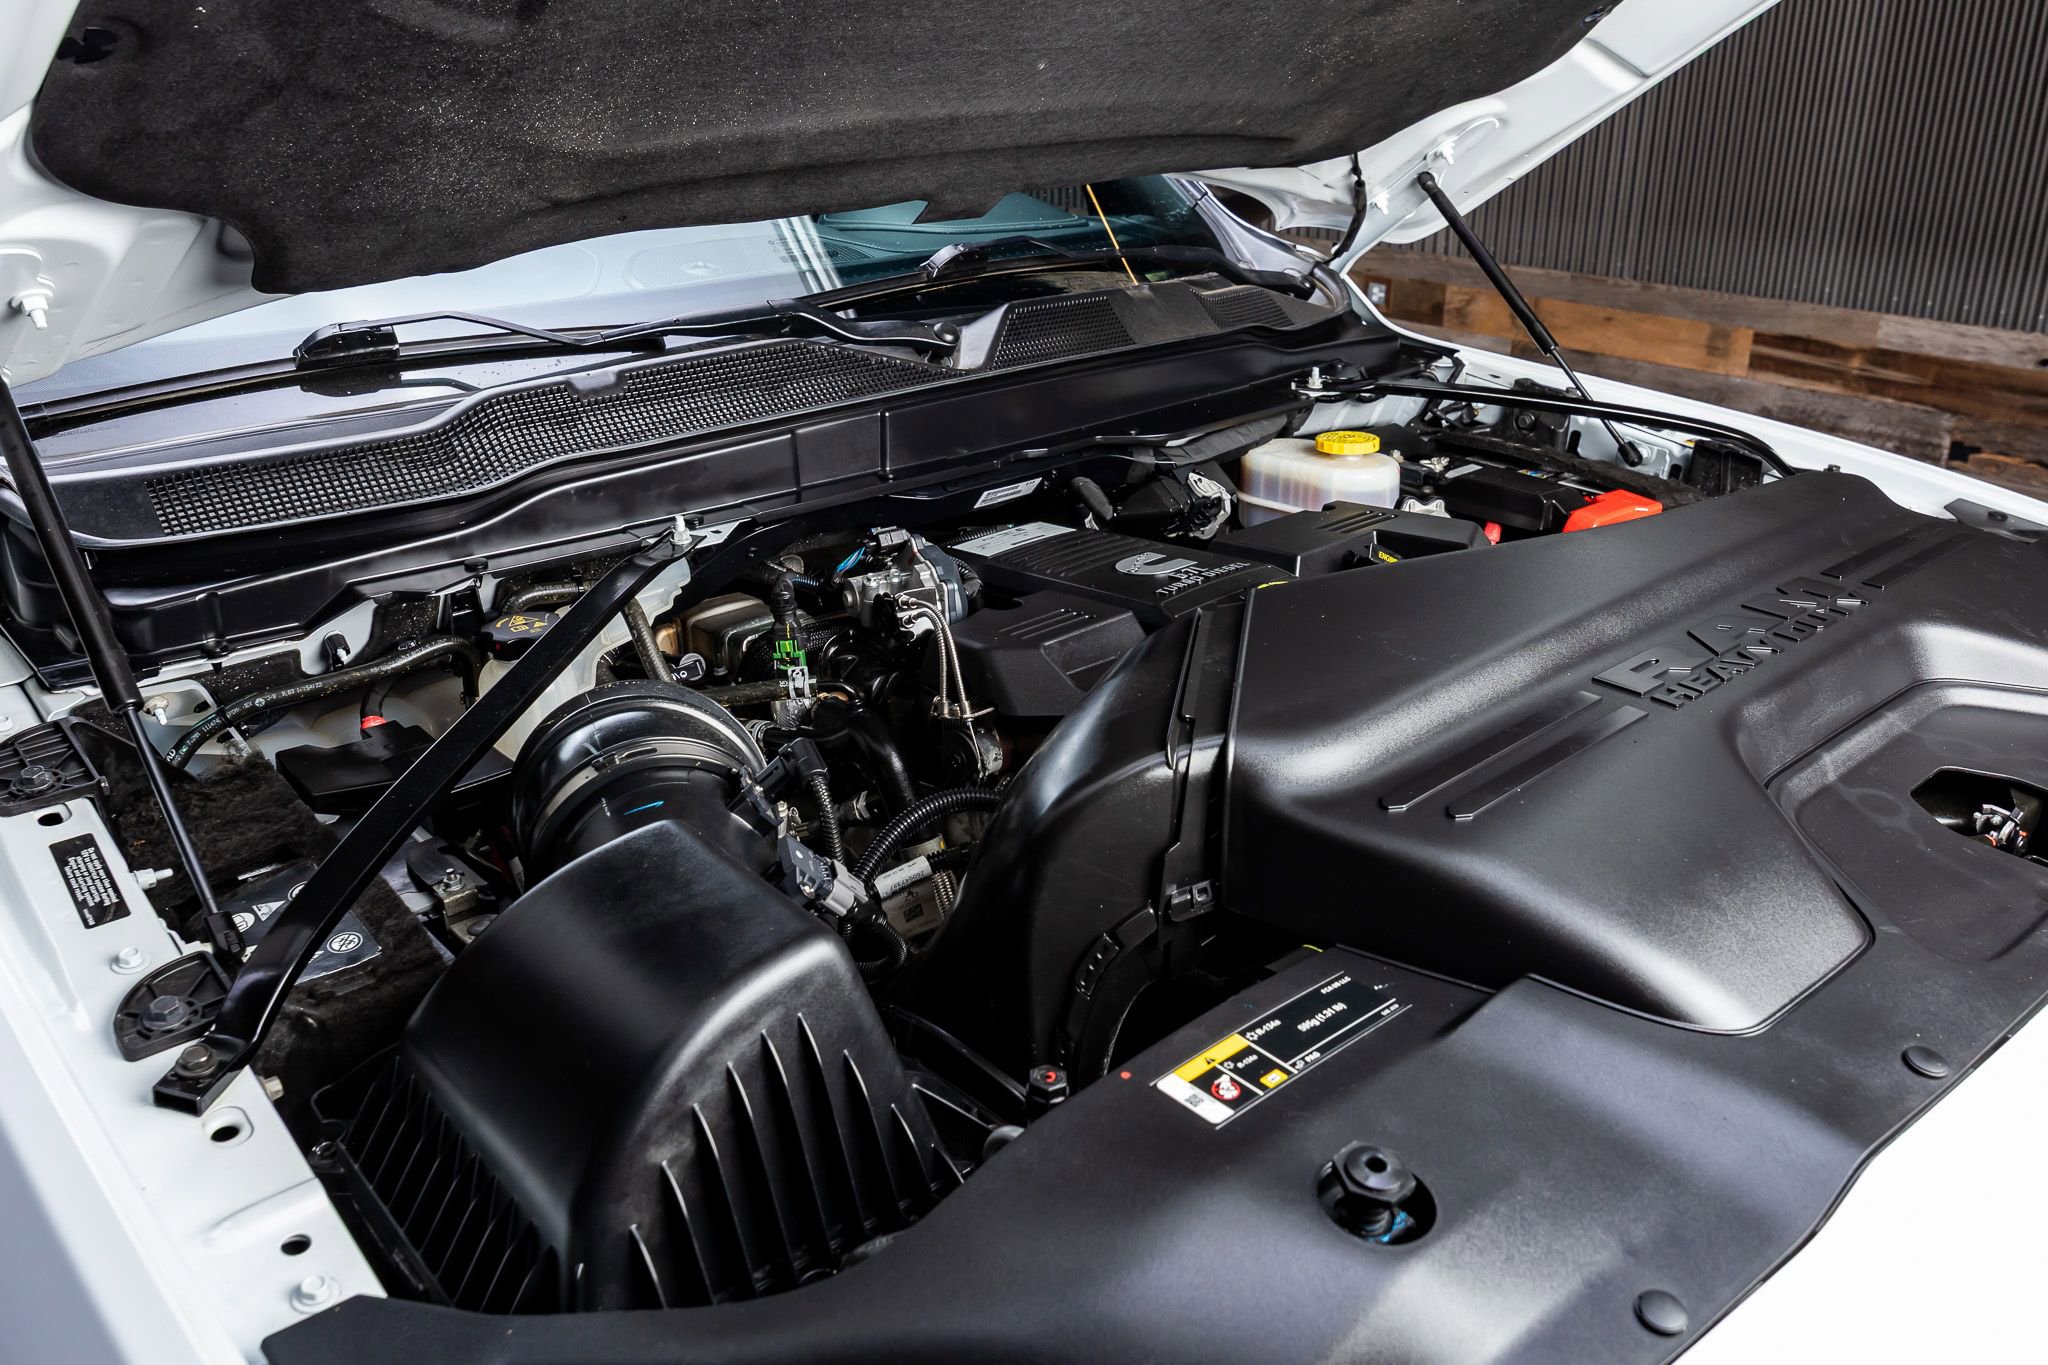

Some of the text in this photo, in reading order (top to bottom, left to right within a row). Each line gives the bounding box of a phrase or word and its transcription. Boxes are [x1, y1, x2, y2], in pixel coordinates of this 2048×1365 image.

[1155, 562, 1251, 595] TURBO DIESEL
[1592, 577, 1847, 697] RAM
[1650, 590, 1872, 710] HEAVY DUTY
